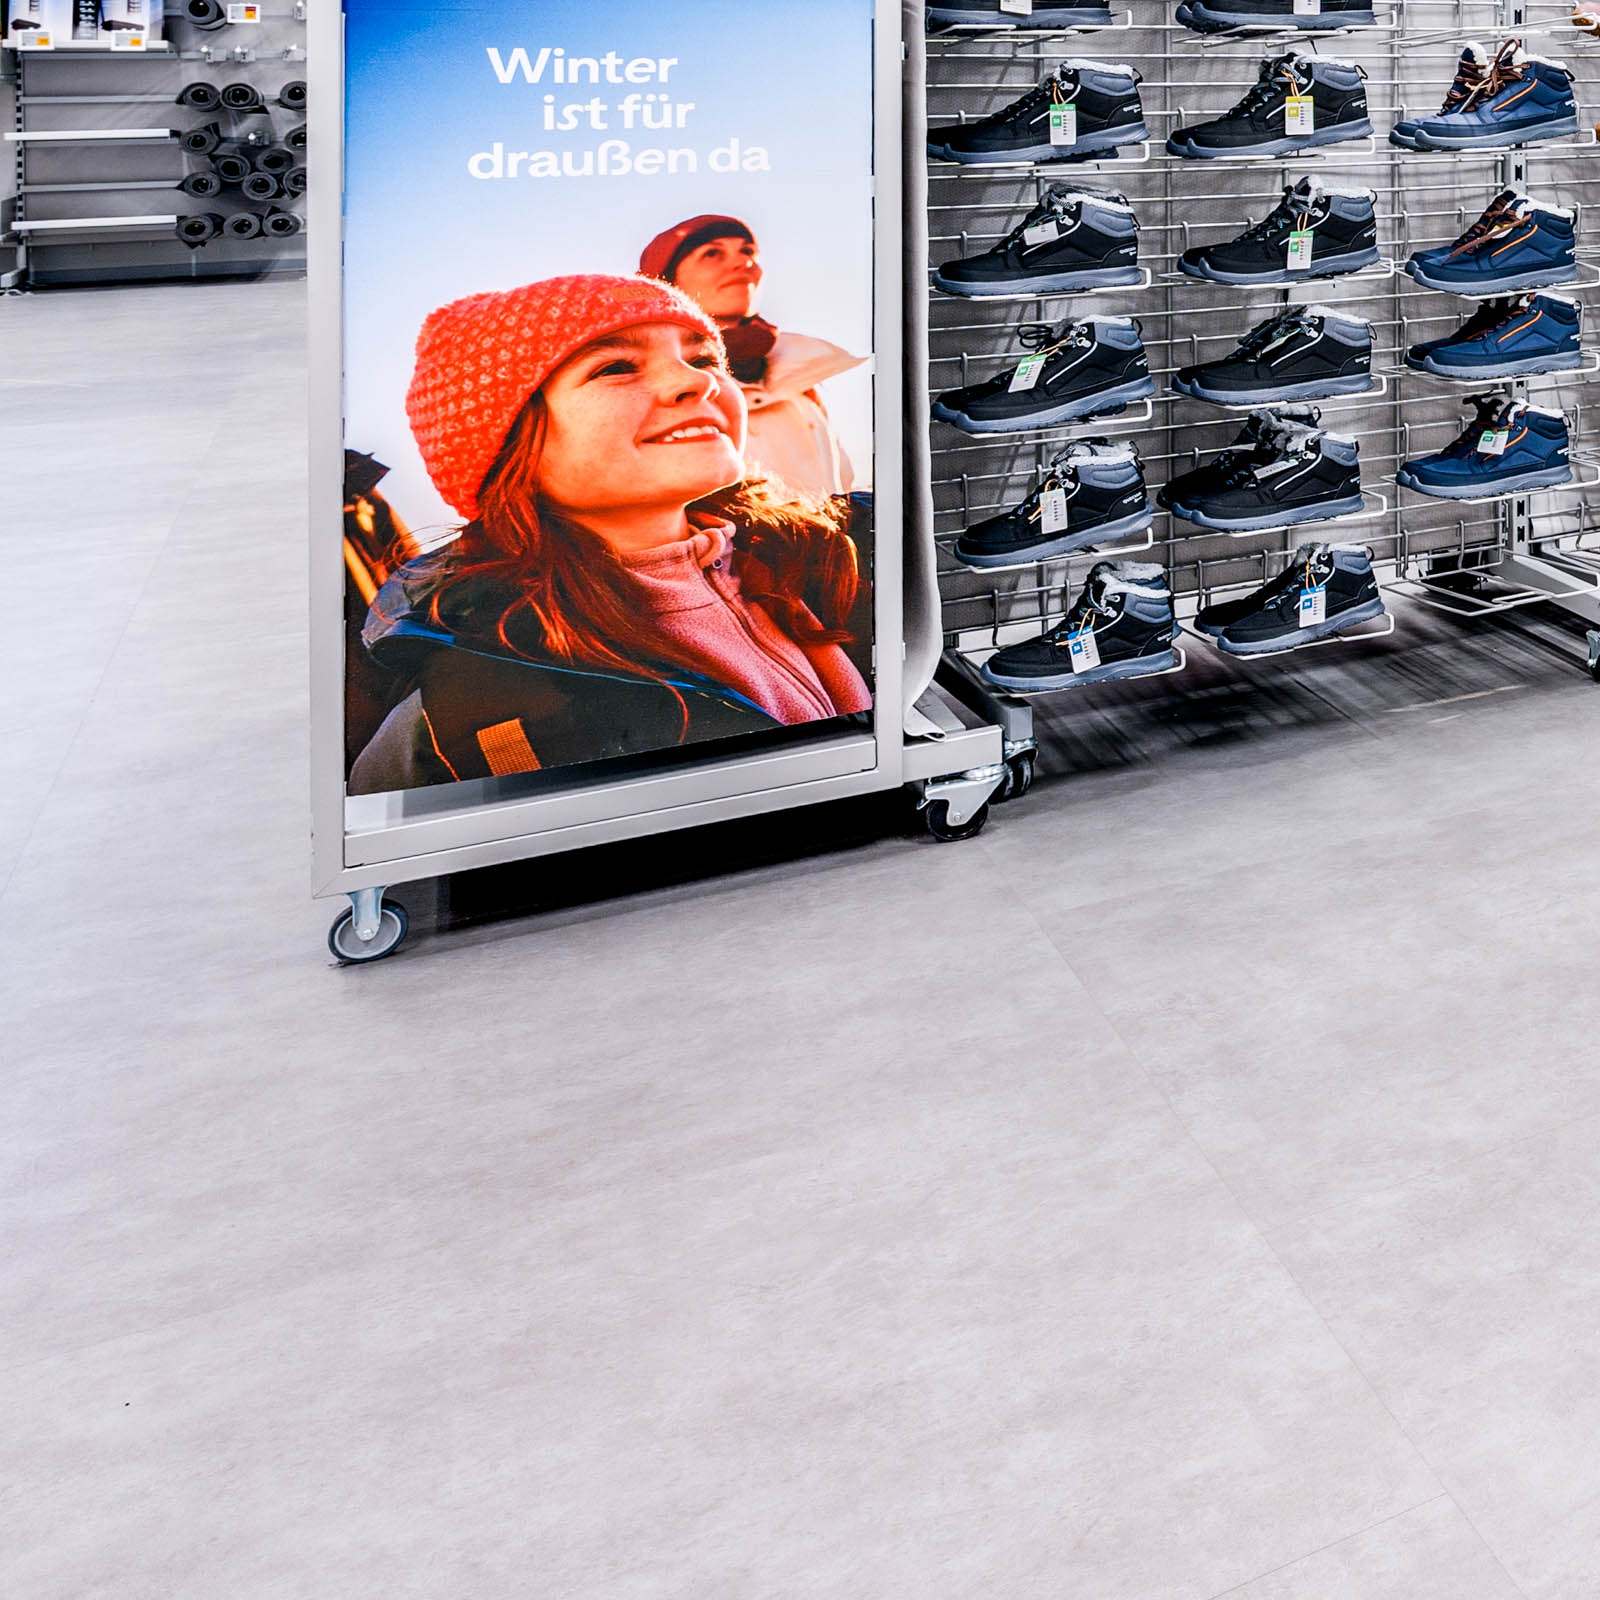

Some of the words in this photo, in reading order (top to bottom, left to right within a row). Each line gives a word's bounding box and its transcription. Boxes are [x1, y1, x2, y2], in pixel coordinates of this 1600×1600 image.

[486, 46, 679, 85] Winter
[543, 93, 608, 131] ist
[617, 93, 697, 130] für
[466, 139, 698, 180] draußen
[707, 136, 772, 174] da
